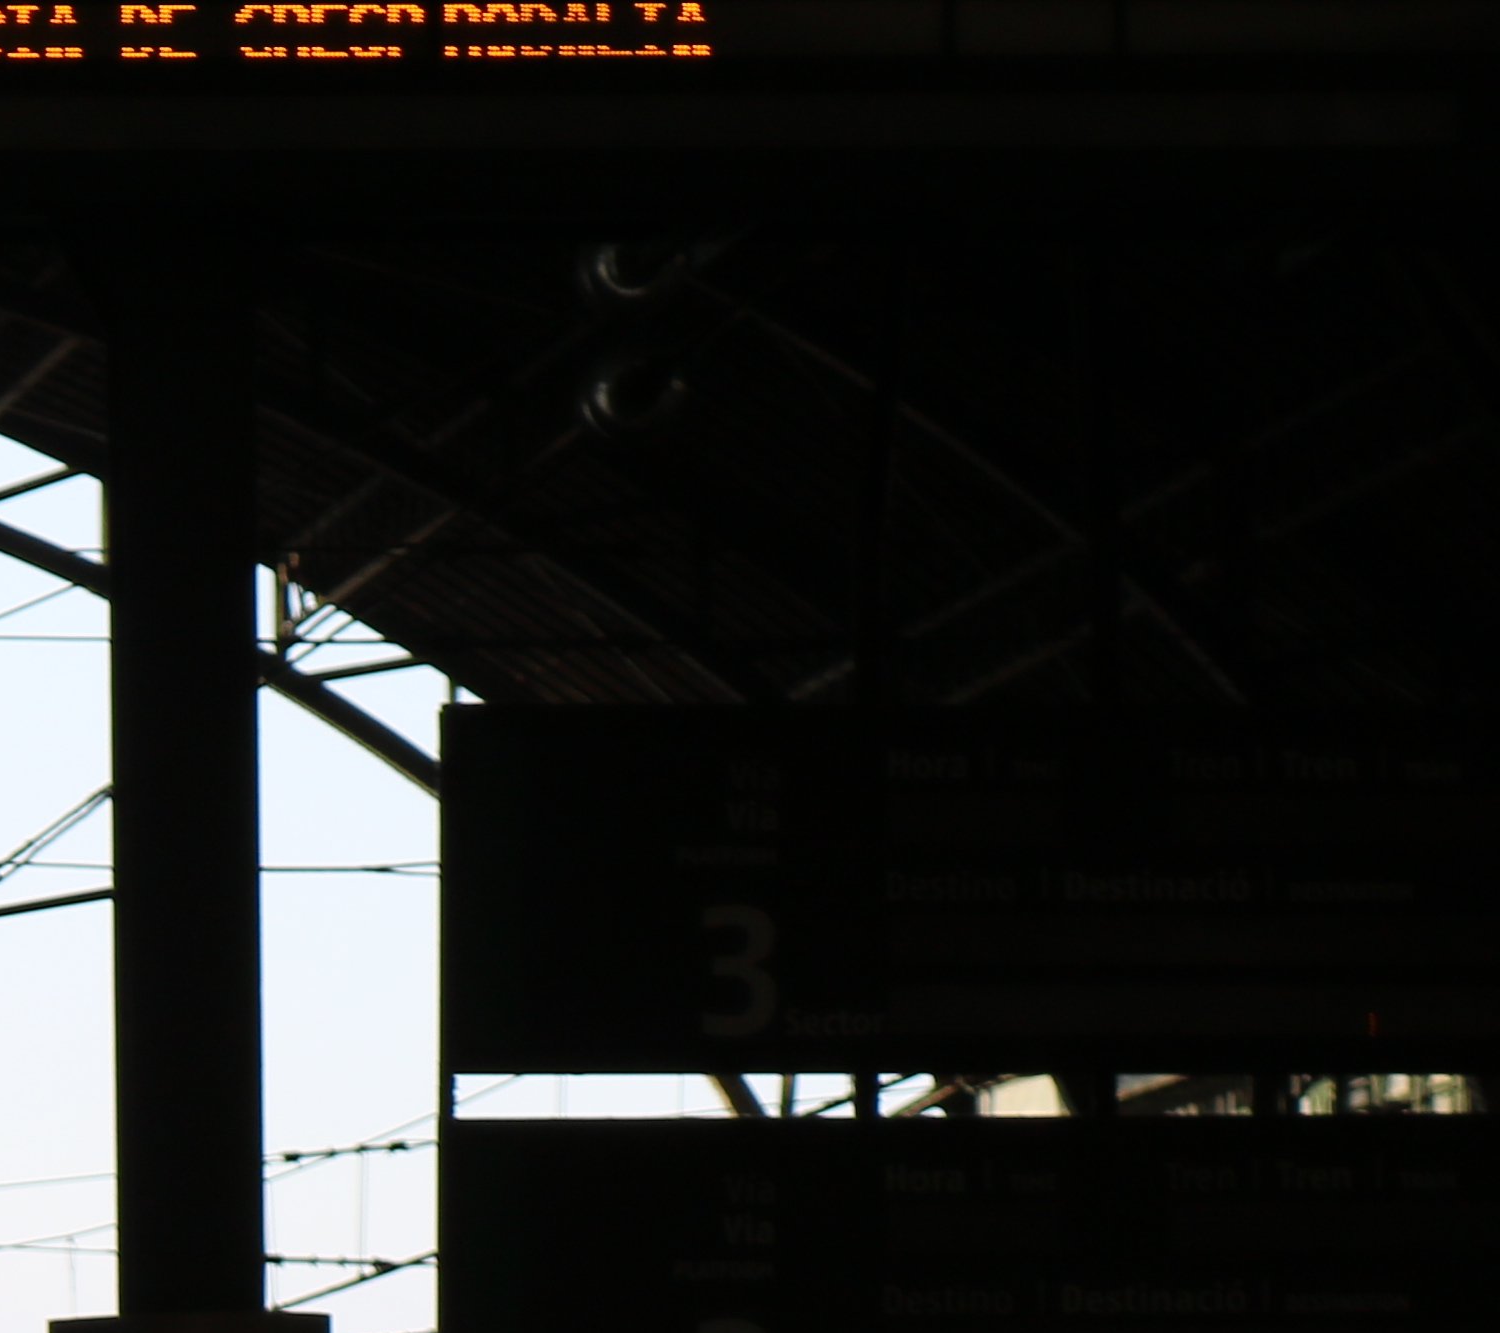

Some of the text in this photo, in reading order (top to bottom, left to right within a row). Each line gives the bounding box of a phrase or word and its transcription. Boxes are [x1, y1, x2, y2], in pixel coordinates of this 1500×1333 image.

[885, 749, 968, 781] Hora
[1169, 748, 1242, 781] Tren
[1280, 748, 1357, 781] Tren
[884, 869, 1017, 902] Destino
[1063, 867, 1251, 903] Destinació
[702, 904, 778, 1037] 3
[784, 1006, 886, 1037] Sector
[883, 1163, 966, 1193] Hora
[1164, 1159, 1239, 1193] Tren
[1275, 1159, 1353, 1192] Tren
[881, 1280, 1015, 1316] Destino
[1060, 1278, 1248, 1316] Destinació
